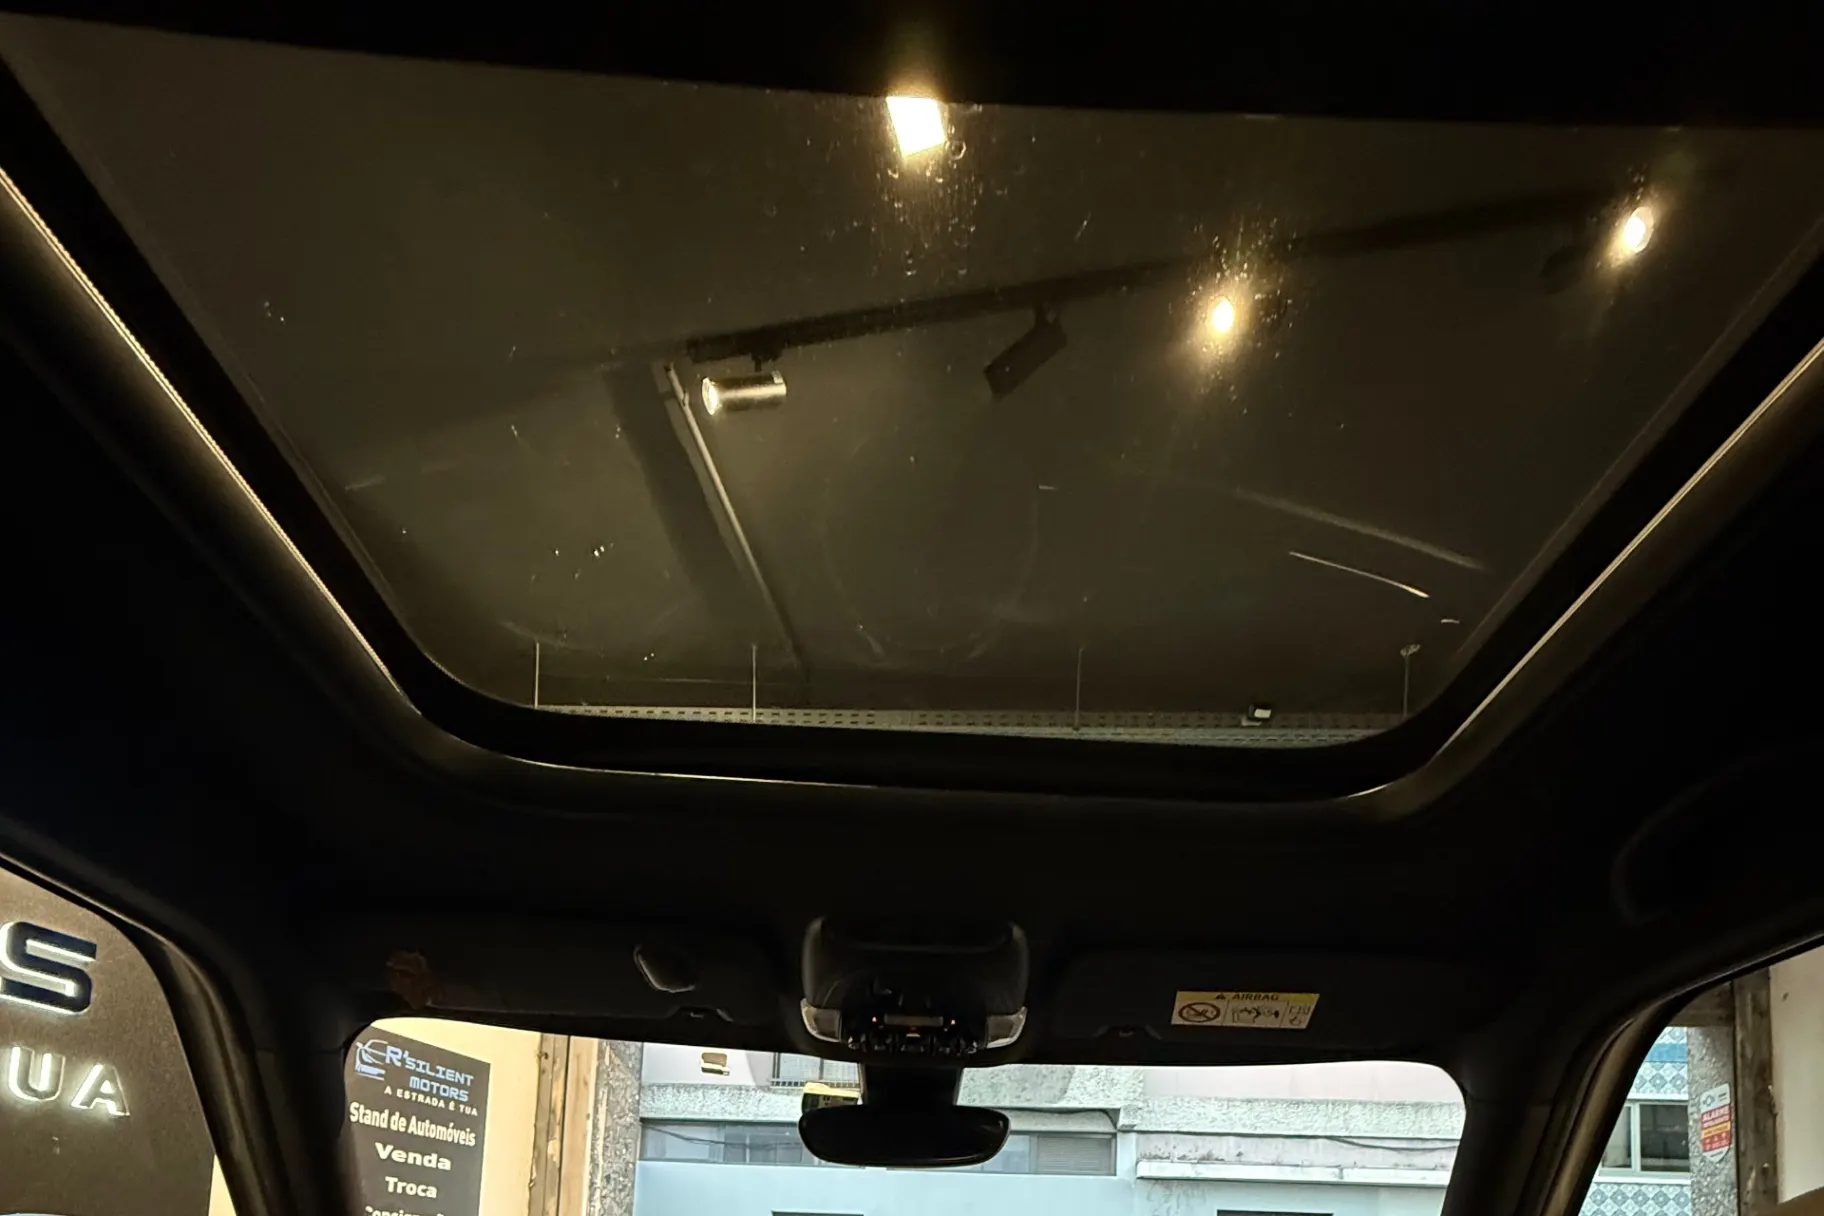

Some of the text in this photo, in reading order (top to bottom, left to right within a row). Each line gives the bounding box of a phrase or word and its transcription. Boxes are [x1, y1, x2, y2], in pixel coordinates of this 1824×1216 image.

[1232, 993, 1280, 1001] AIRBAG
[384, 1086, 478, 1116] A ESTRADA É TUA
[409, 1076, 469, 1102] MOTORS
[350, 1102, 476, 1146] Stand de Automóveis
[375, 1142, 452, 1171] Venda
[385, 1176, 438, 1198] Troca
